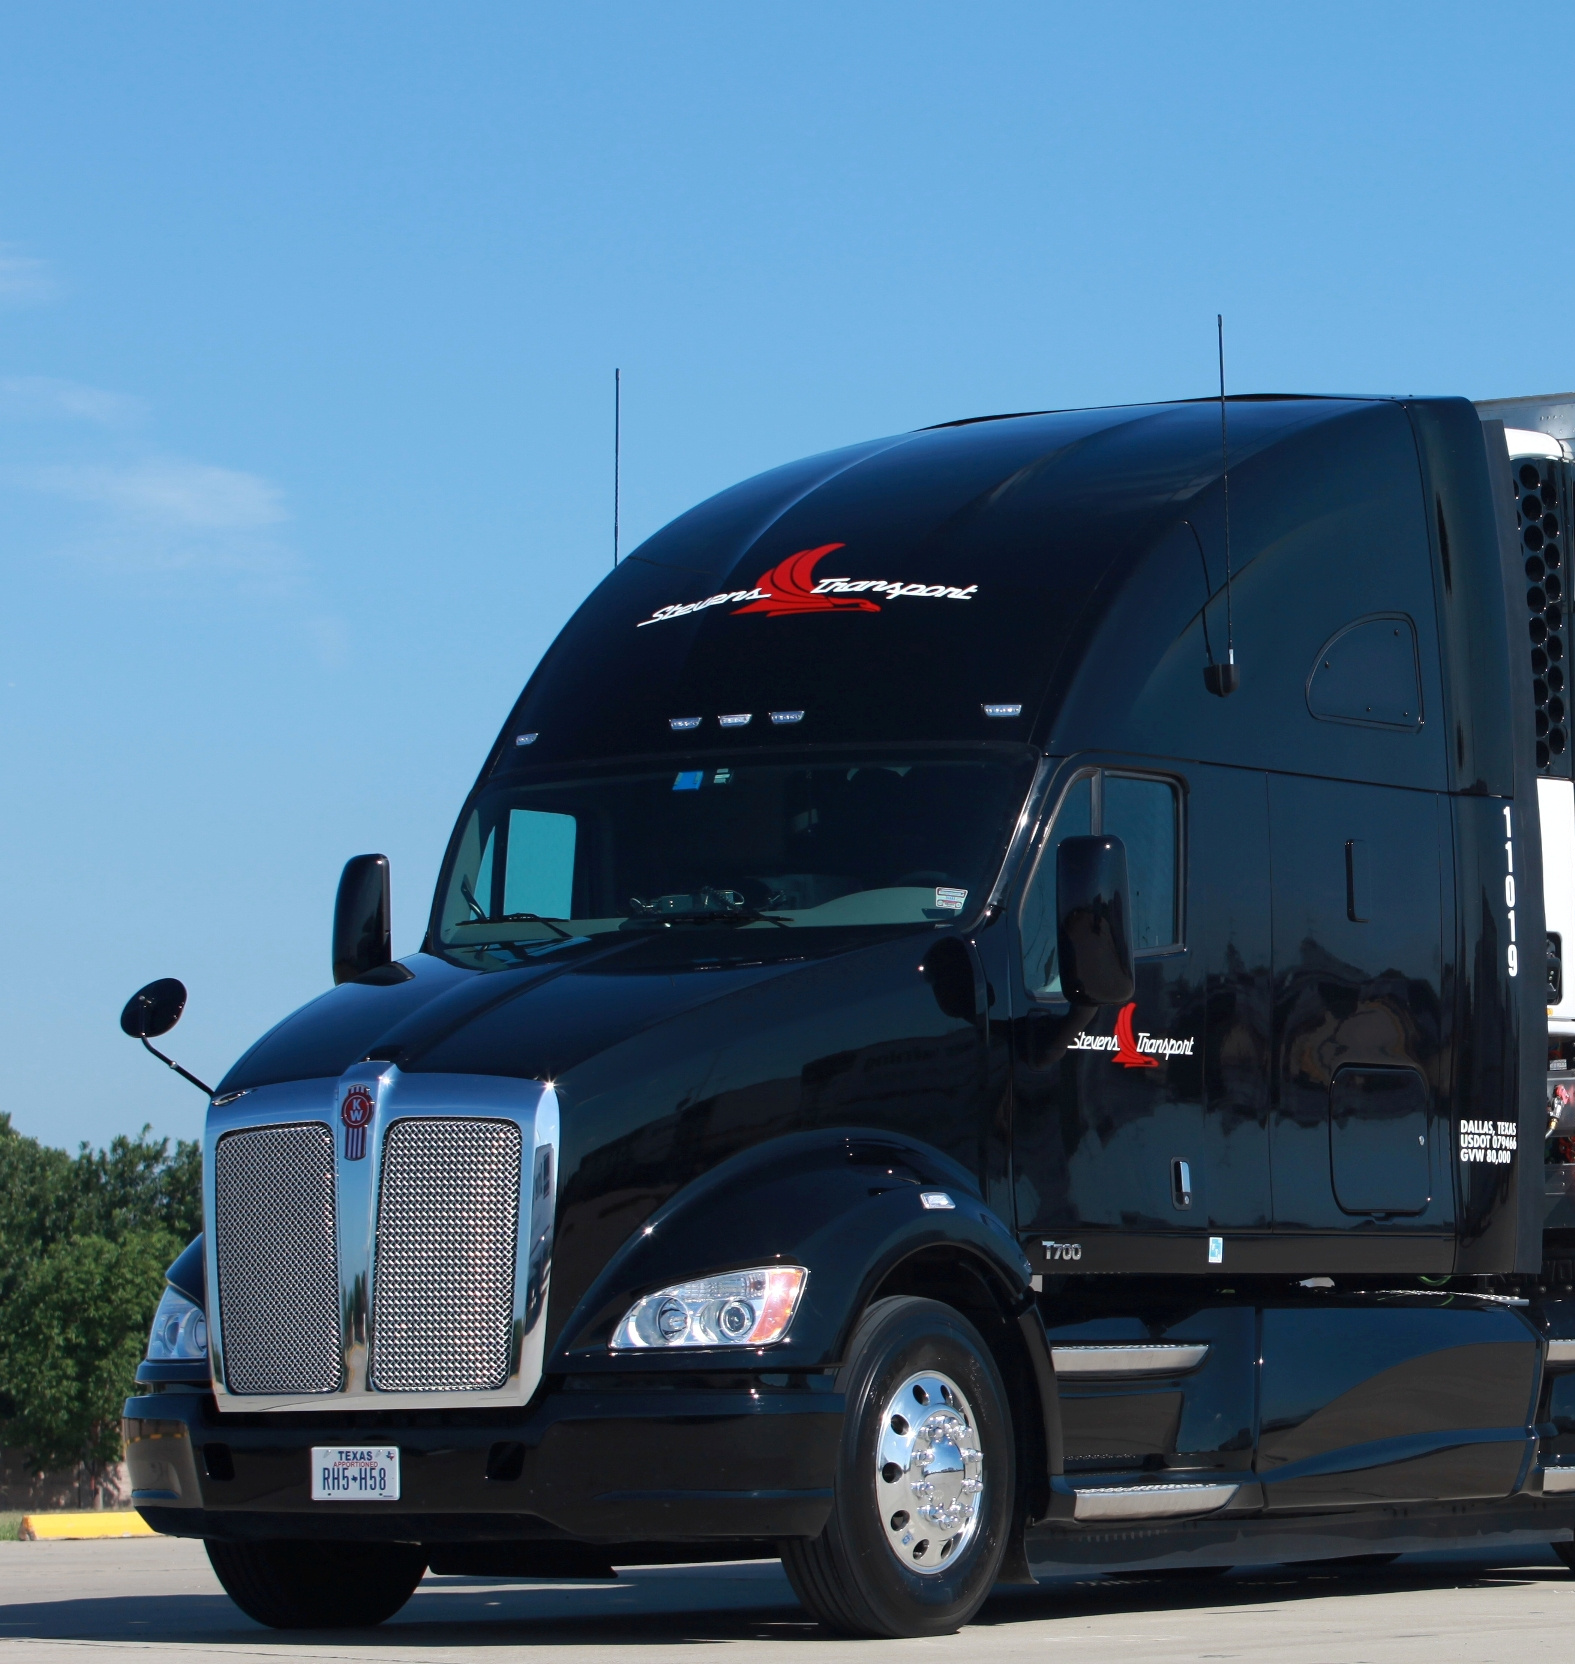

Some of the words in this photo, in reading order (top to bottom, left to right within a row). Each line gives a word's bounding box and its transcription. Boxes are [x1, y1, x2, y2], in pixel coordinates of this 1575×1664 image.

[637, 588, 772, 627] Stevens
[810, 578, 979, 600] Transport
[1503, 806, 1518, 977] 11019
[1067, 1032, 1121, 1051] Stevens
[1136, 1033, 1194, 1060] Transport
[1460, 1120, 1496, 1136] DALLAS,
[1497, 1121, 1517, 1136] TEXAS
[1460, 1134, 1491, 1149] USDOT
[1460, 1149, 1485, 1162] GVW
[1486, 1150, 1511, 1165] 80,000
[1042, 1241, 1082, 1260] T700
[338, 1450, 373, 1461] TEXAS
